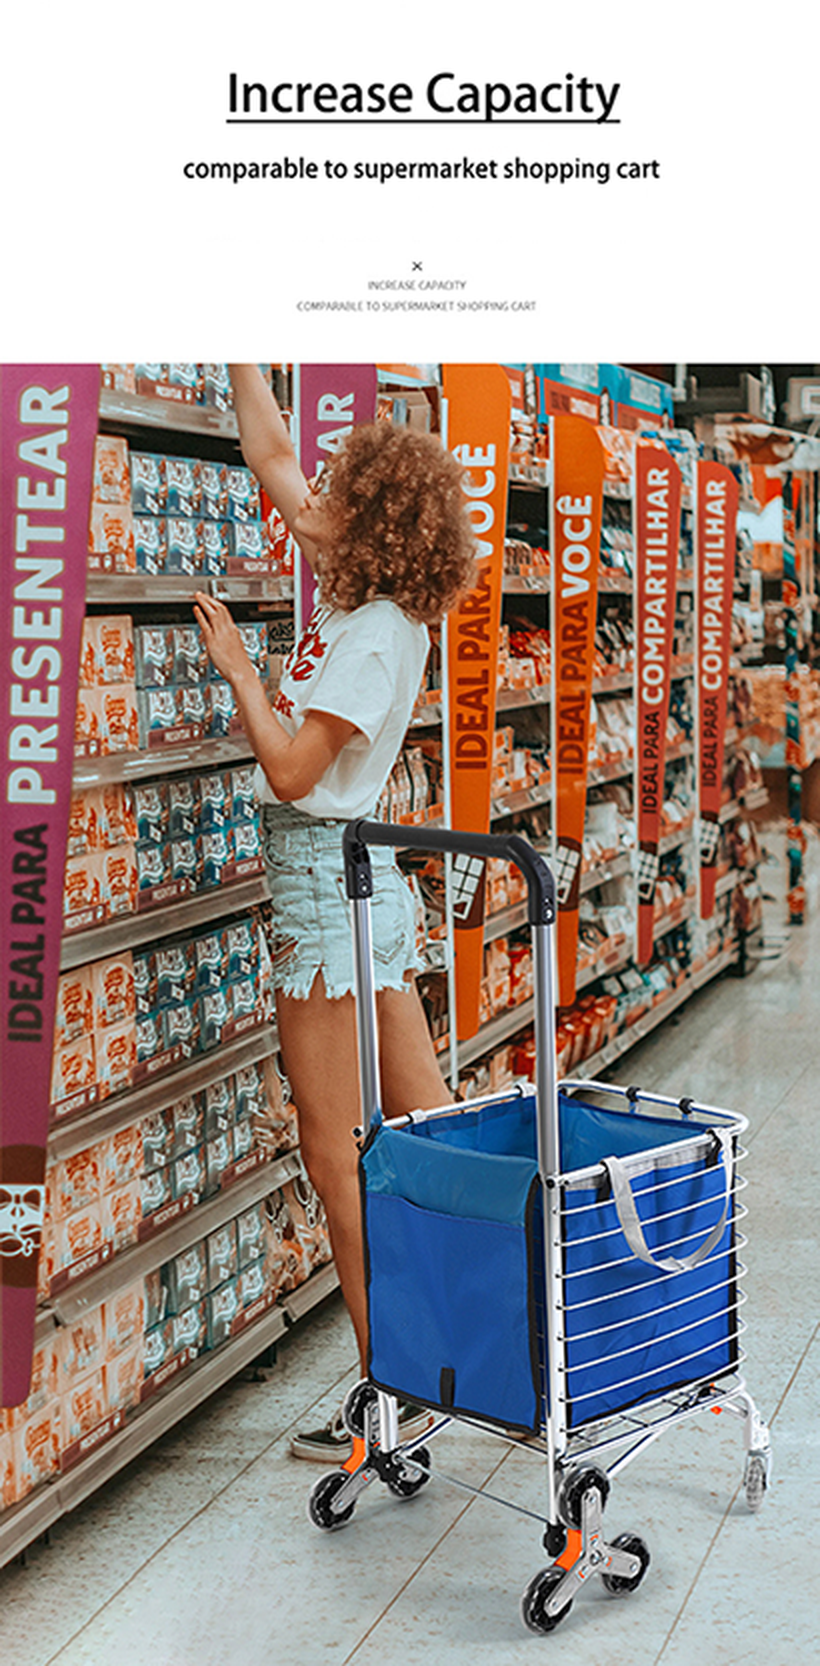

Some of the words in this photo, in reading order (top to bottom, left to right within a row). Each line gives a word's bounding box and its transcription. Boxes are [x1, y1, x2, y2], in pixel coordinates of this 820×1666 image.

[7, 384, 71, 805] PRESENTEAR
[556, 495, 593, 599] VOCÊ
[642, 467, 670, 705] COMPARTILHAR
[702, 479, 727, 690] COMPARTILHAR
[560, 601, 589, 682] PARA
[455, 669, 489, 770] IDEAL
[558, 690, 586, 774] IDEAL
[644, 710, 661, 760] PARA
[703, 695, 719, 739] PARA
[703, 740, 719, 788] IDEAL
[643, 761, 659, 815] IDEAL
[11, 823, 48, 925] PARA
[7, 933, 45, 1043] IDEAL
